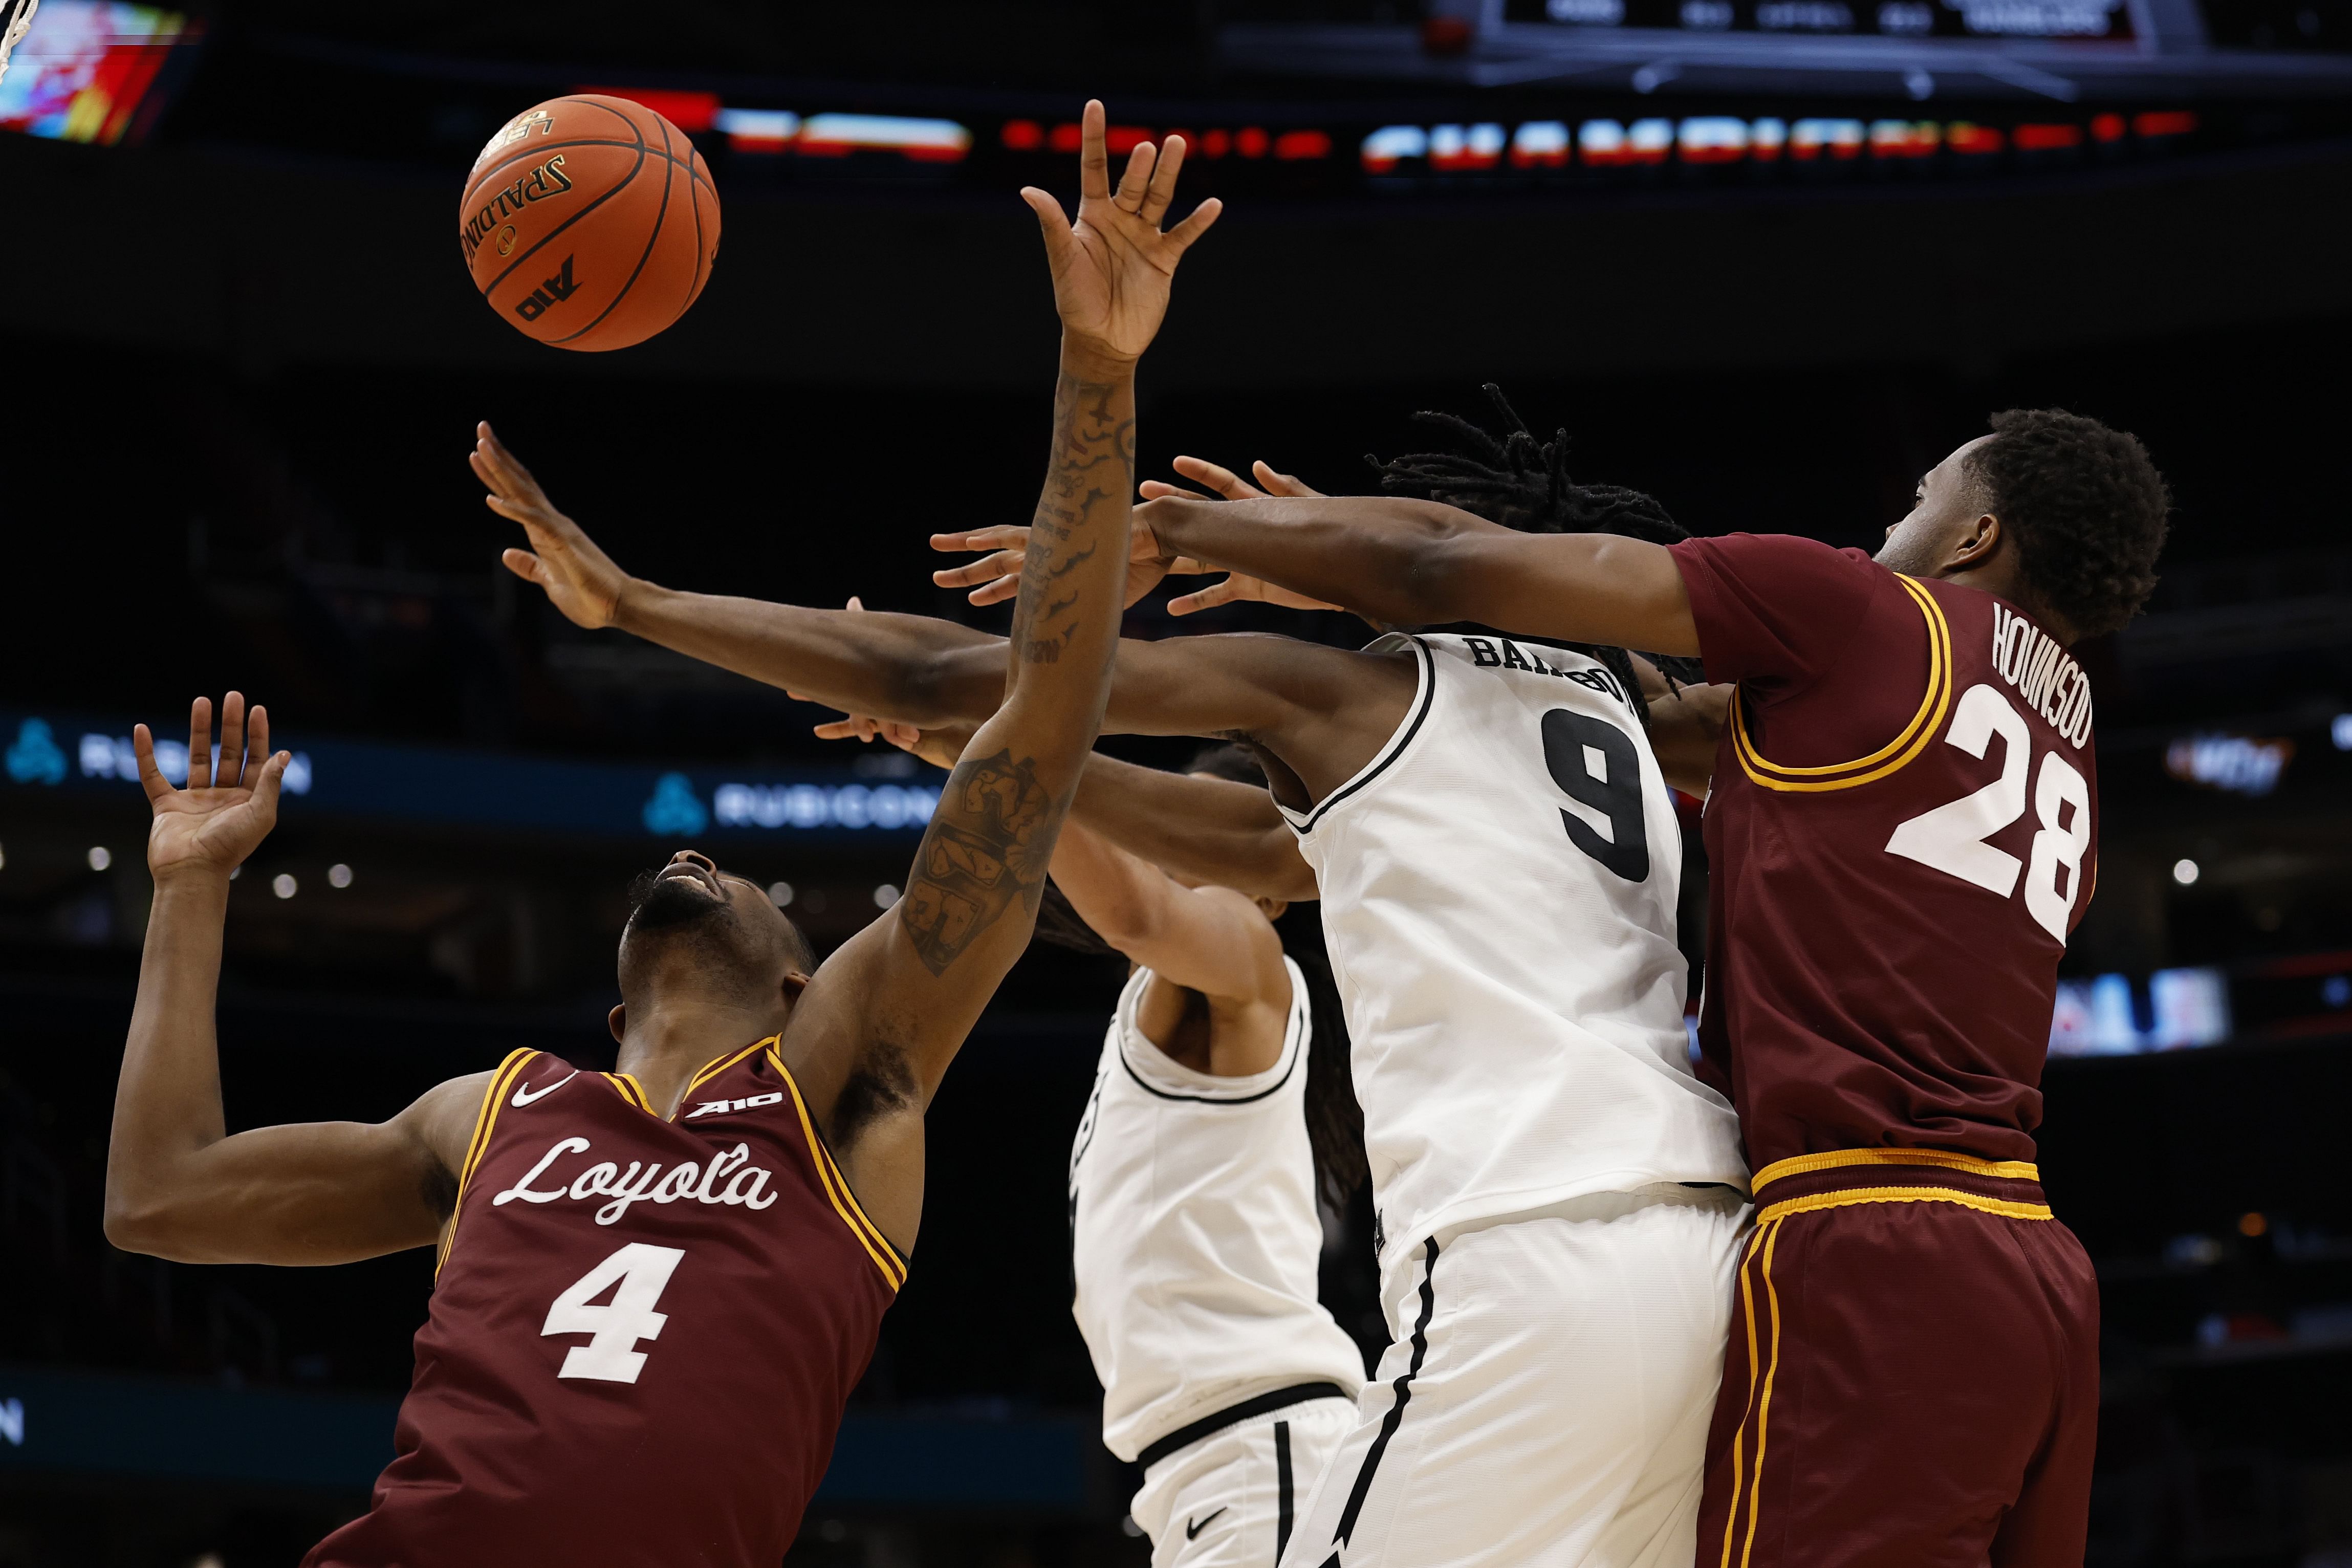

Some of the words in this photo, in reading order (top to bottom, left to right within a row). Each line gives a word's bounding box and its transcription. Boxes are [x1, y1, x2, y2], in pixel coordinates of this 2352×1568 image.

[461, 155, 572, 271] SPALDING
[1541, 708, 1650, 883] 9
[1884, 684, 2090, 948] 28
[684, 1092, 782, 1118] A10
[492, 1137, 778, 1225] Loyola
[540, 1243, 686, 1384] 4
